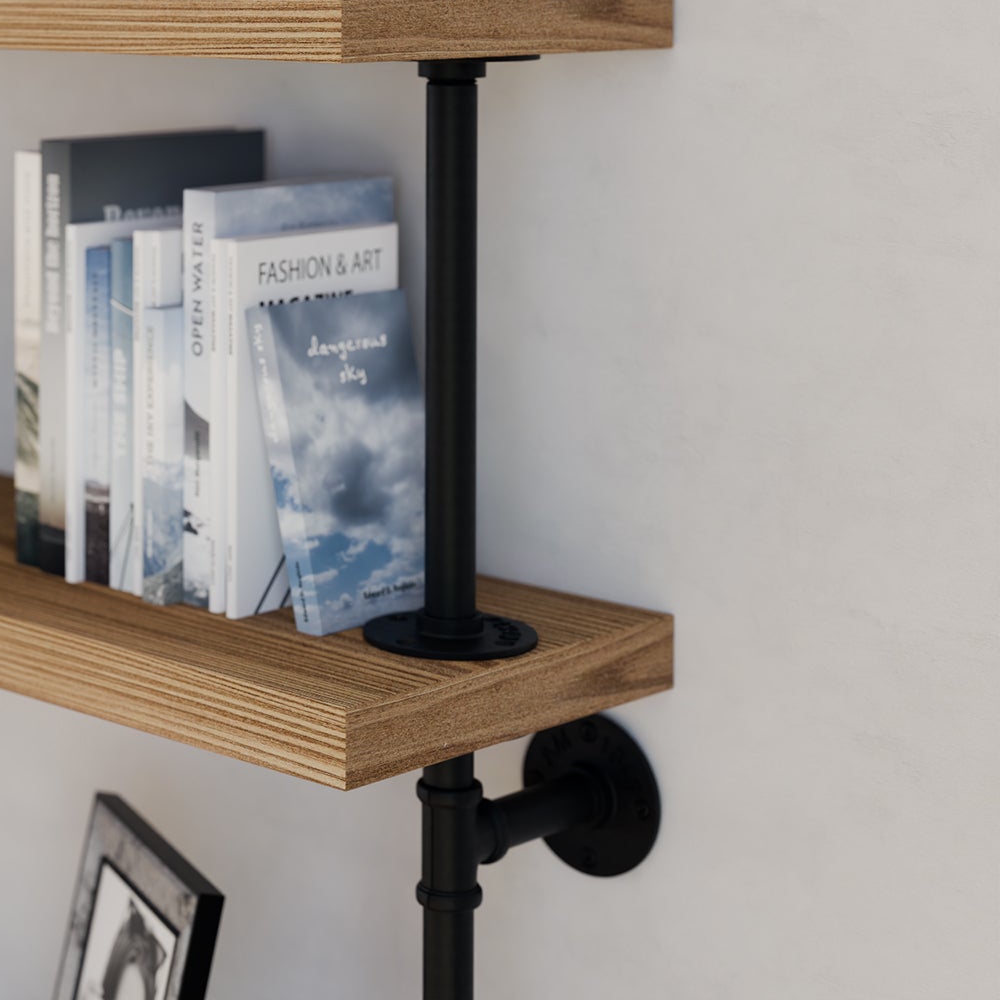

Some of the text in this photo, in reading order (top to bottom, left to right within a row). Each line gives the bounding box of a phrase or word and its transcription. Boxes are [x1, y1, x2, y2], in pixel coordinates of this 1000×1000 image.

[258, 247, 383, 286] FASHION & ART
[191, 221, 204, 357] OPEN WATER
[307, 332, 388, 361] dangerous
[338, 362, 368, 387] sky
